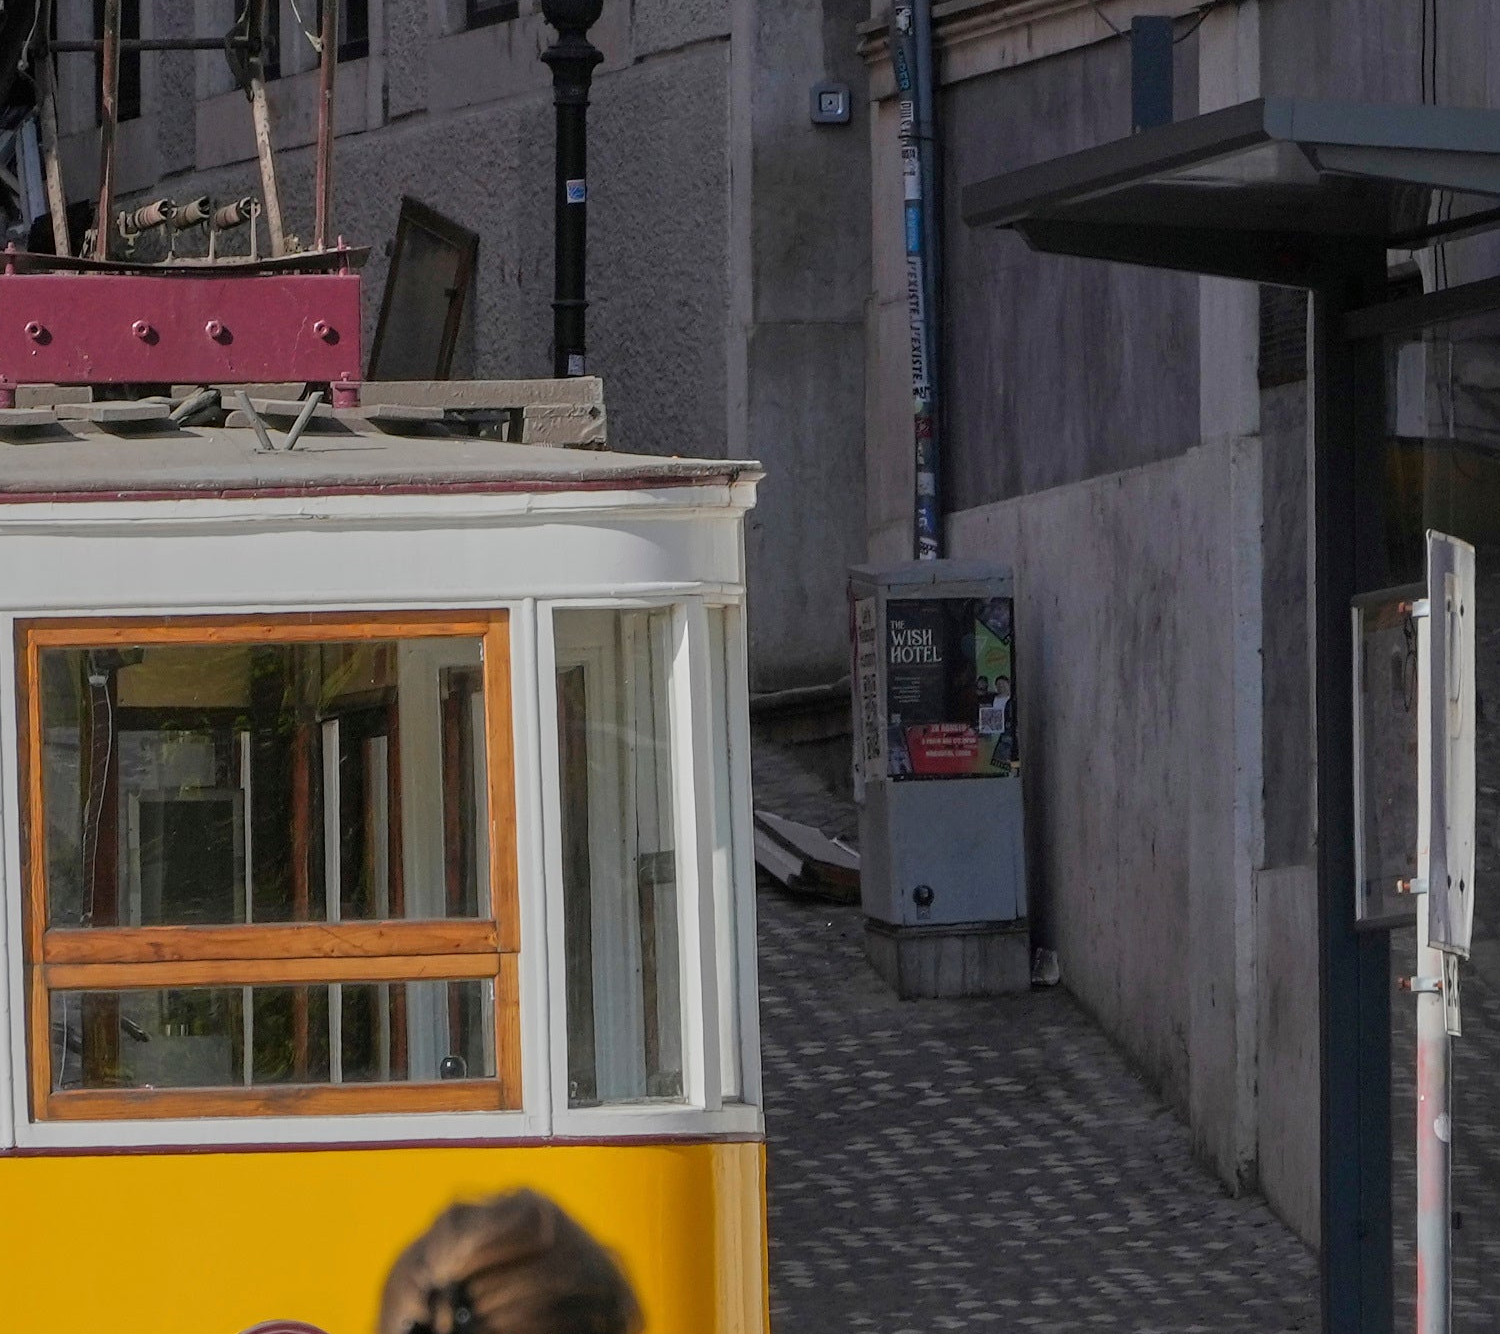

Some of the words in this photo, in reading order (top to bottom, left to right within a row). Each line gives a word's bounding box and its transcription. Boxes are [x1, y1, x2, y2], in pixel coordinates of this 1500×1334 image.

[890, 620, 905, 629] THE
[890, 629, 933, 646] WISH
[890, 646, 943, 664] HOTEL
